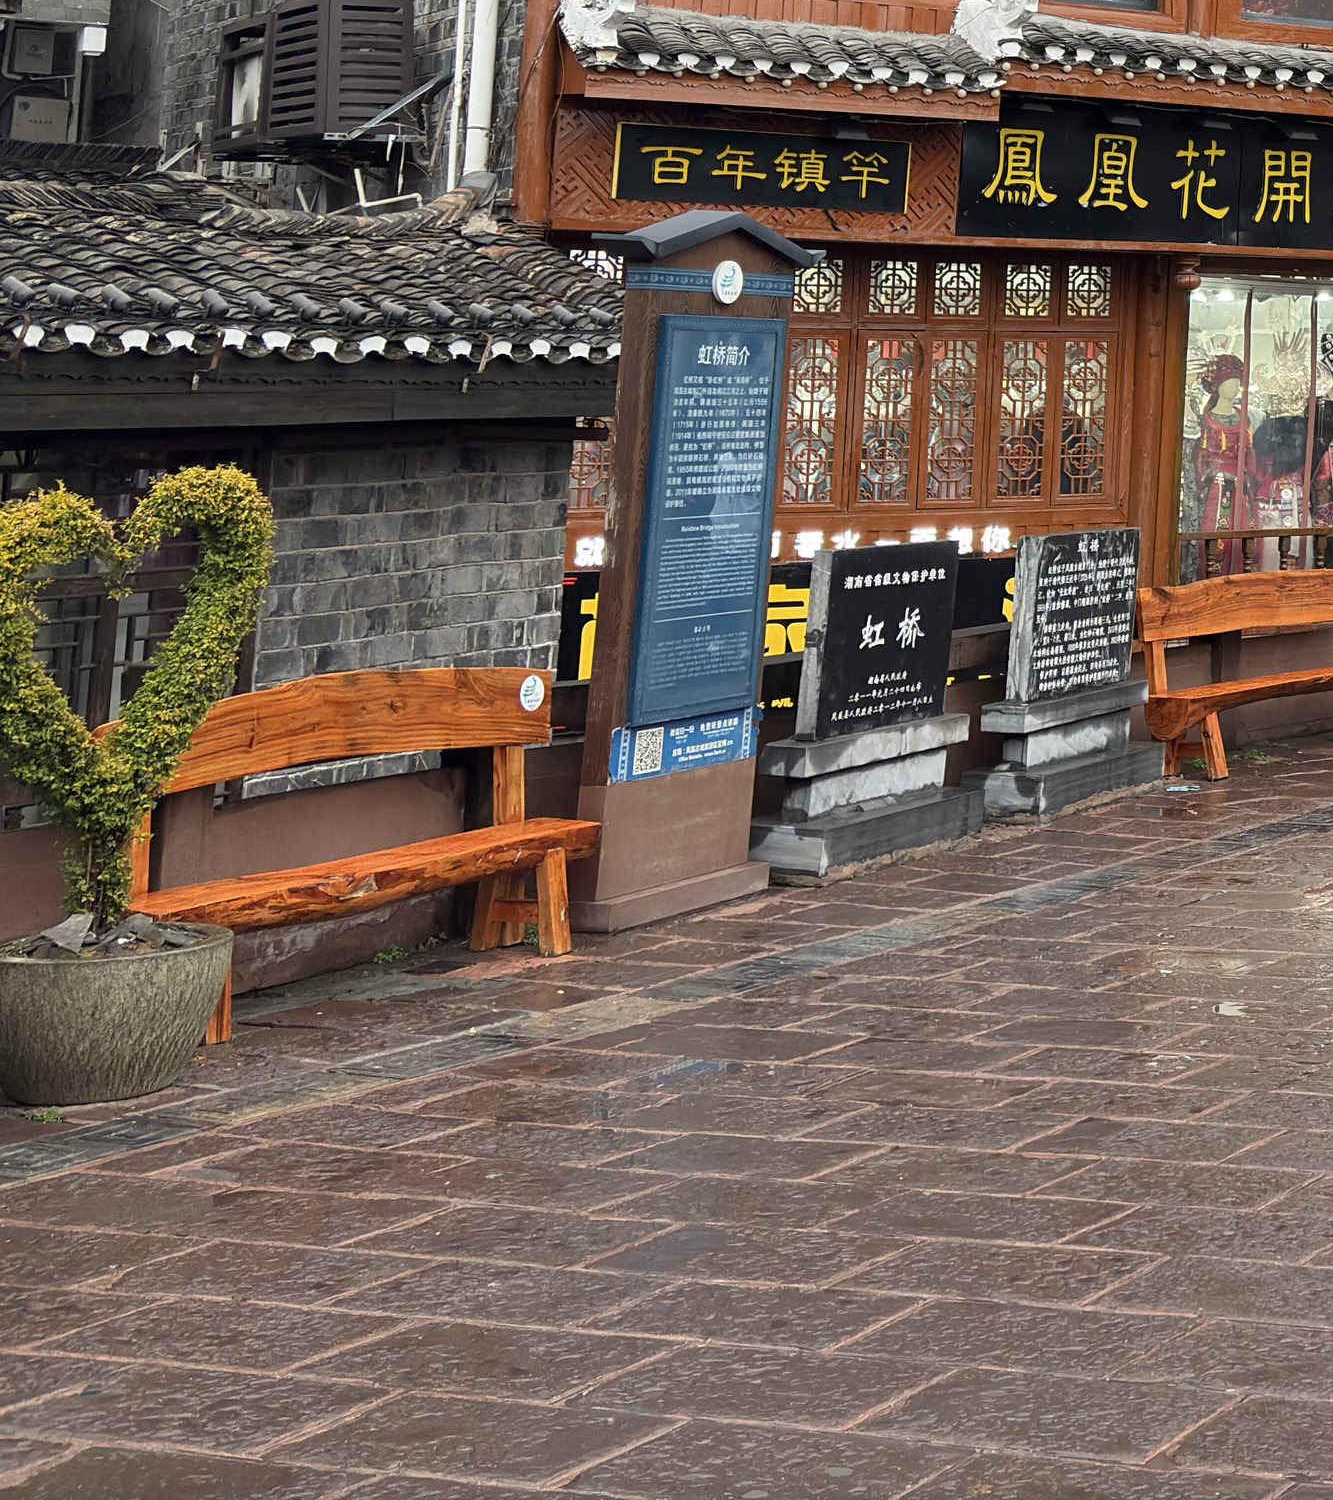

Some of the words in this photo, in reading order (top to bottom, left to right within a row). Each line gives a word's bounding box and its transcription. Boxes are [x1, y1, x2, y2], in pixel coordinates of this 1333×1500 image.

[697, 344, 751, 366] 虹桥简介
[1077, 539, 1100, 553] 虹桥
[844, 568, 946, 590] 湖南省省级文物保护单位
[859, 607, 926, 649] 虹桥
